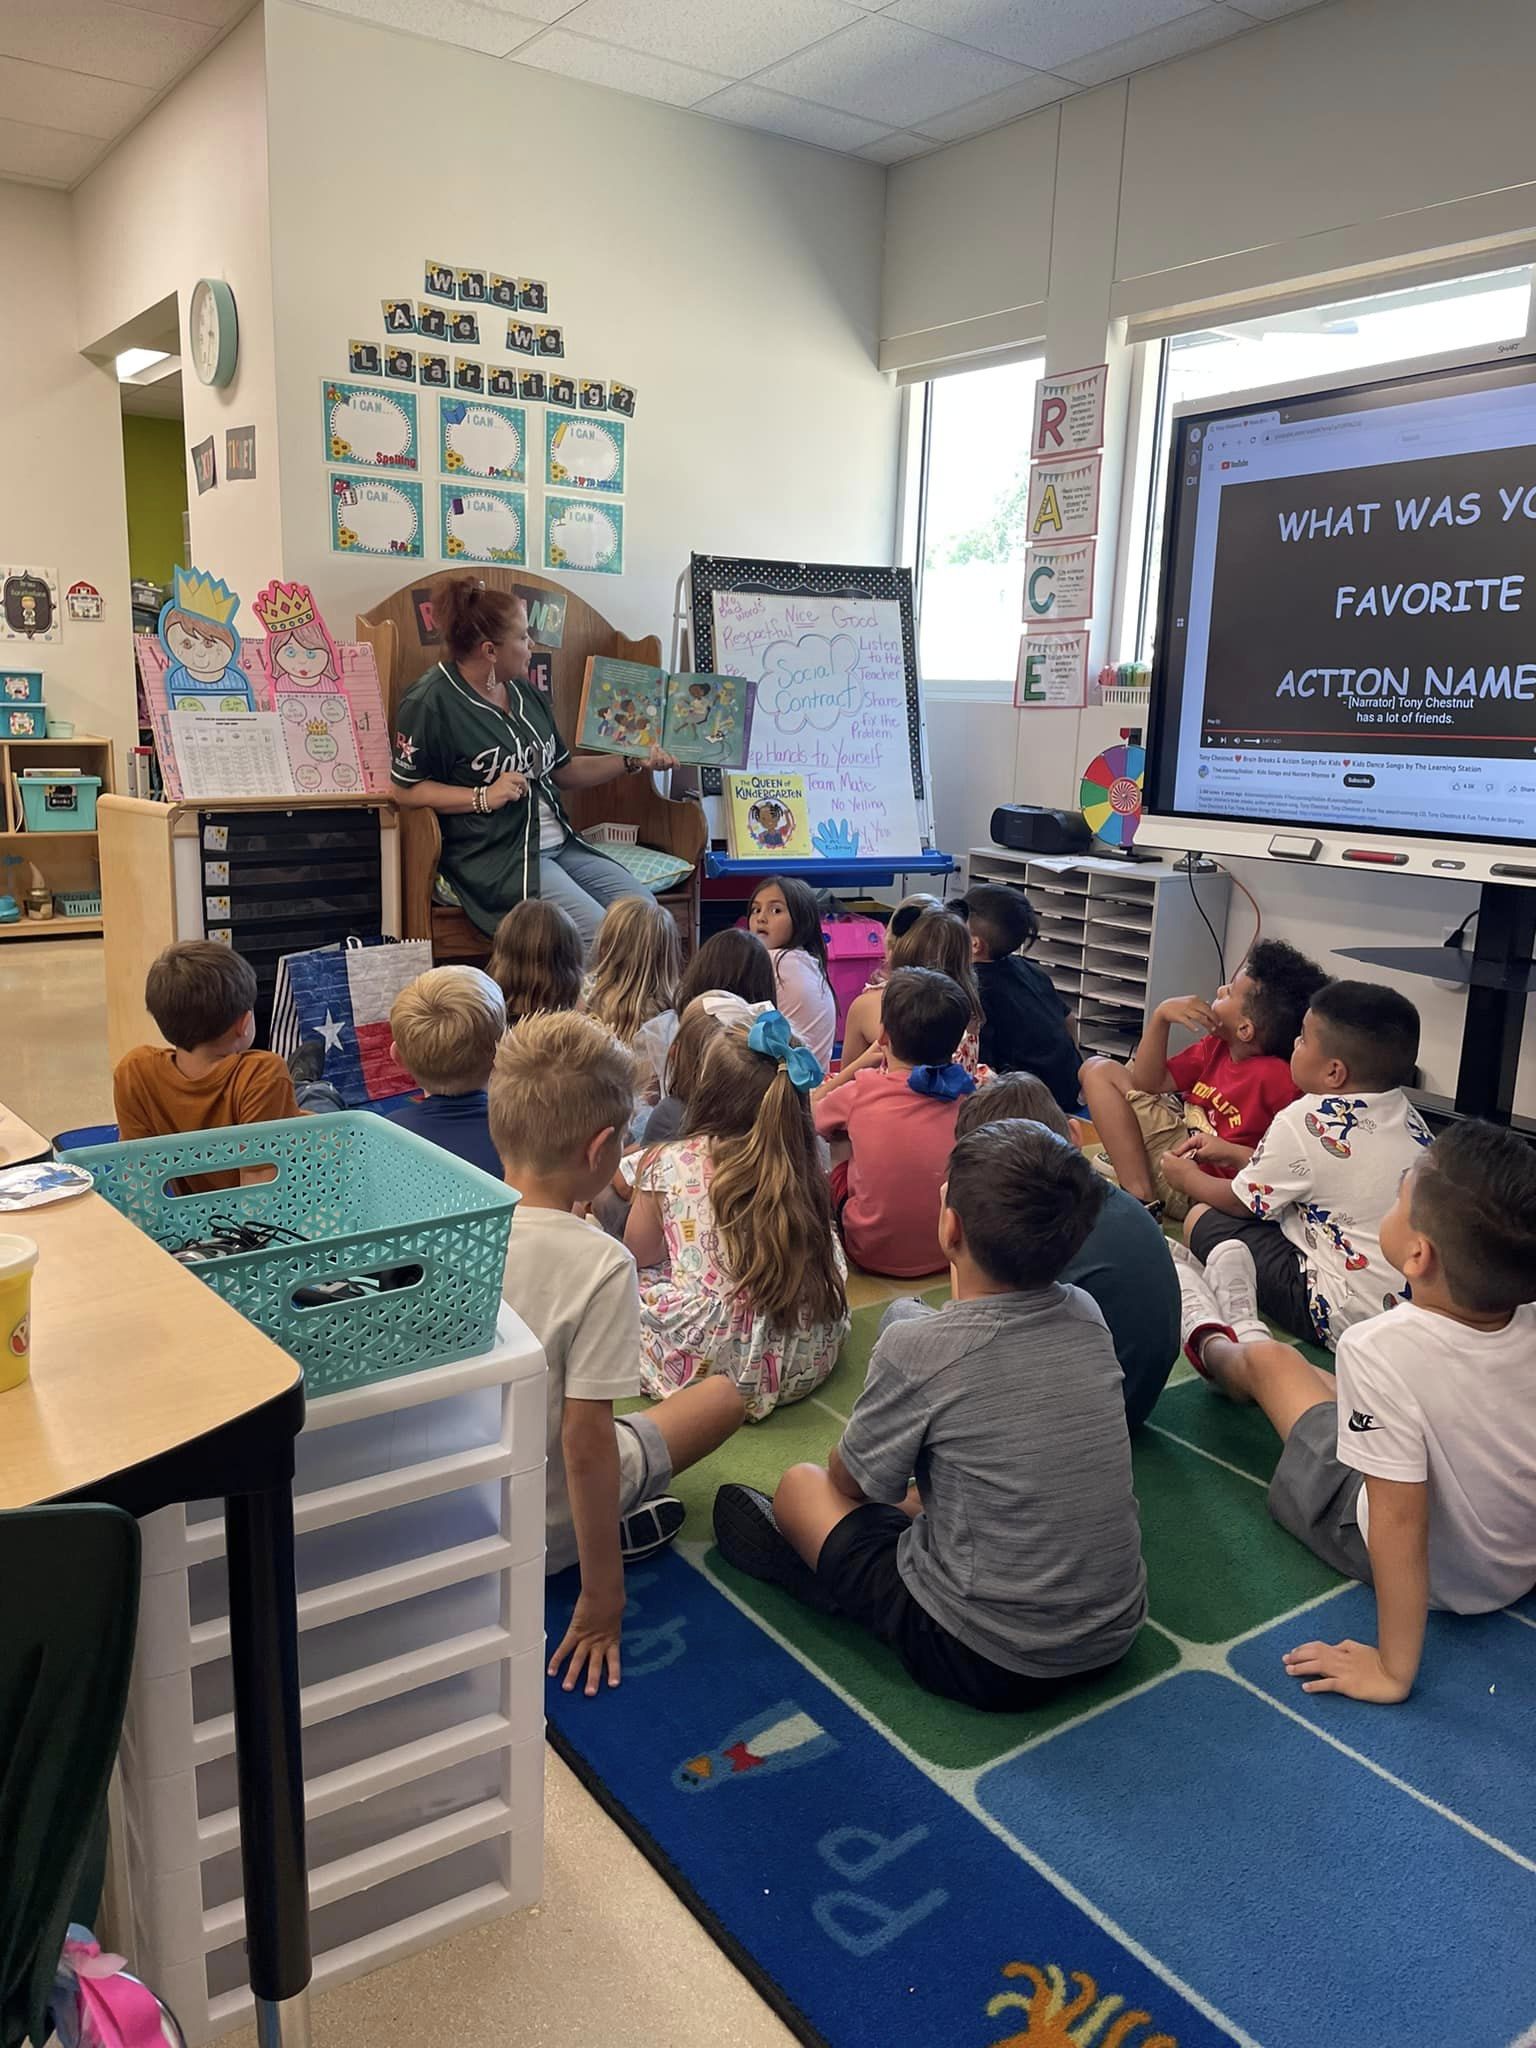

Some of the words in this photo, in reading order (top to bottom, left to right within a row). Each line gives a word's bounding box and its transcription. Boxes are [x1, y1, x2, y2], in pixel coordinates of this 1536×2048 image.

[1497, 342, 1521, 354] SMART
[360, 348, 628, 408] Learning?
[1040, 398, 1066, 449] R
[376, 452, 416, 469] Spelling
[1033, 484, 1064, 534] A
[1278, 502, 1381, 542] WHAT
[1395, 492, 1481, 531] WAS
[1028, 566, 1056, 615] C
[1335, 575, 1525, 619] FAVORITE
[786, 604, 820, 622] Nice
[832, 606, 878, 628] Good
[860, 634, 898, 650] Listen
[777, 652, 834, 689] Social
[868, 651, 882, 663] to
[858, 666, 900, 681] Teacher
[1024, 654, 1047, 701] E
[1276, 666, 1410, 698] ACTION
[1424, 663, 1536, 700] NAME
[774, 675, 857, 715] Contract
[1348, 695, 1396, 710] [Narrator]
[1398, 696, 1423, 710] Tony
[1425, 696, 1474, 709] Chestnut
[1356, 712, 1374, 723] has
[1377, 714, 1384, 723] a
[1386, 712, 1400, 724] lot
[1401, 712, 1414, 724] of
[1415, 712, 1455, 724] friends.
[766, 742, 808, 764] Hands
[834, 742, 883, 772] Yourself
[1301, 758, 1318, 766] Songs
[1386, 762, 1404, 770] Songs
[1406, 762, 1413, 770] by
[1428, 764, 1456, 773] Learning
[1458, 765, 1482, 773] Station
[752, 776, 782, 788] QUEEN
[806, 773, 834, 792] Team
[832, 800, 845, 810] No
[850, 800, 887, 816] Yelling
[1212, 1092, 1242, 1129] LIFE
